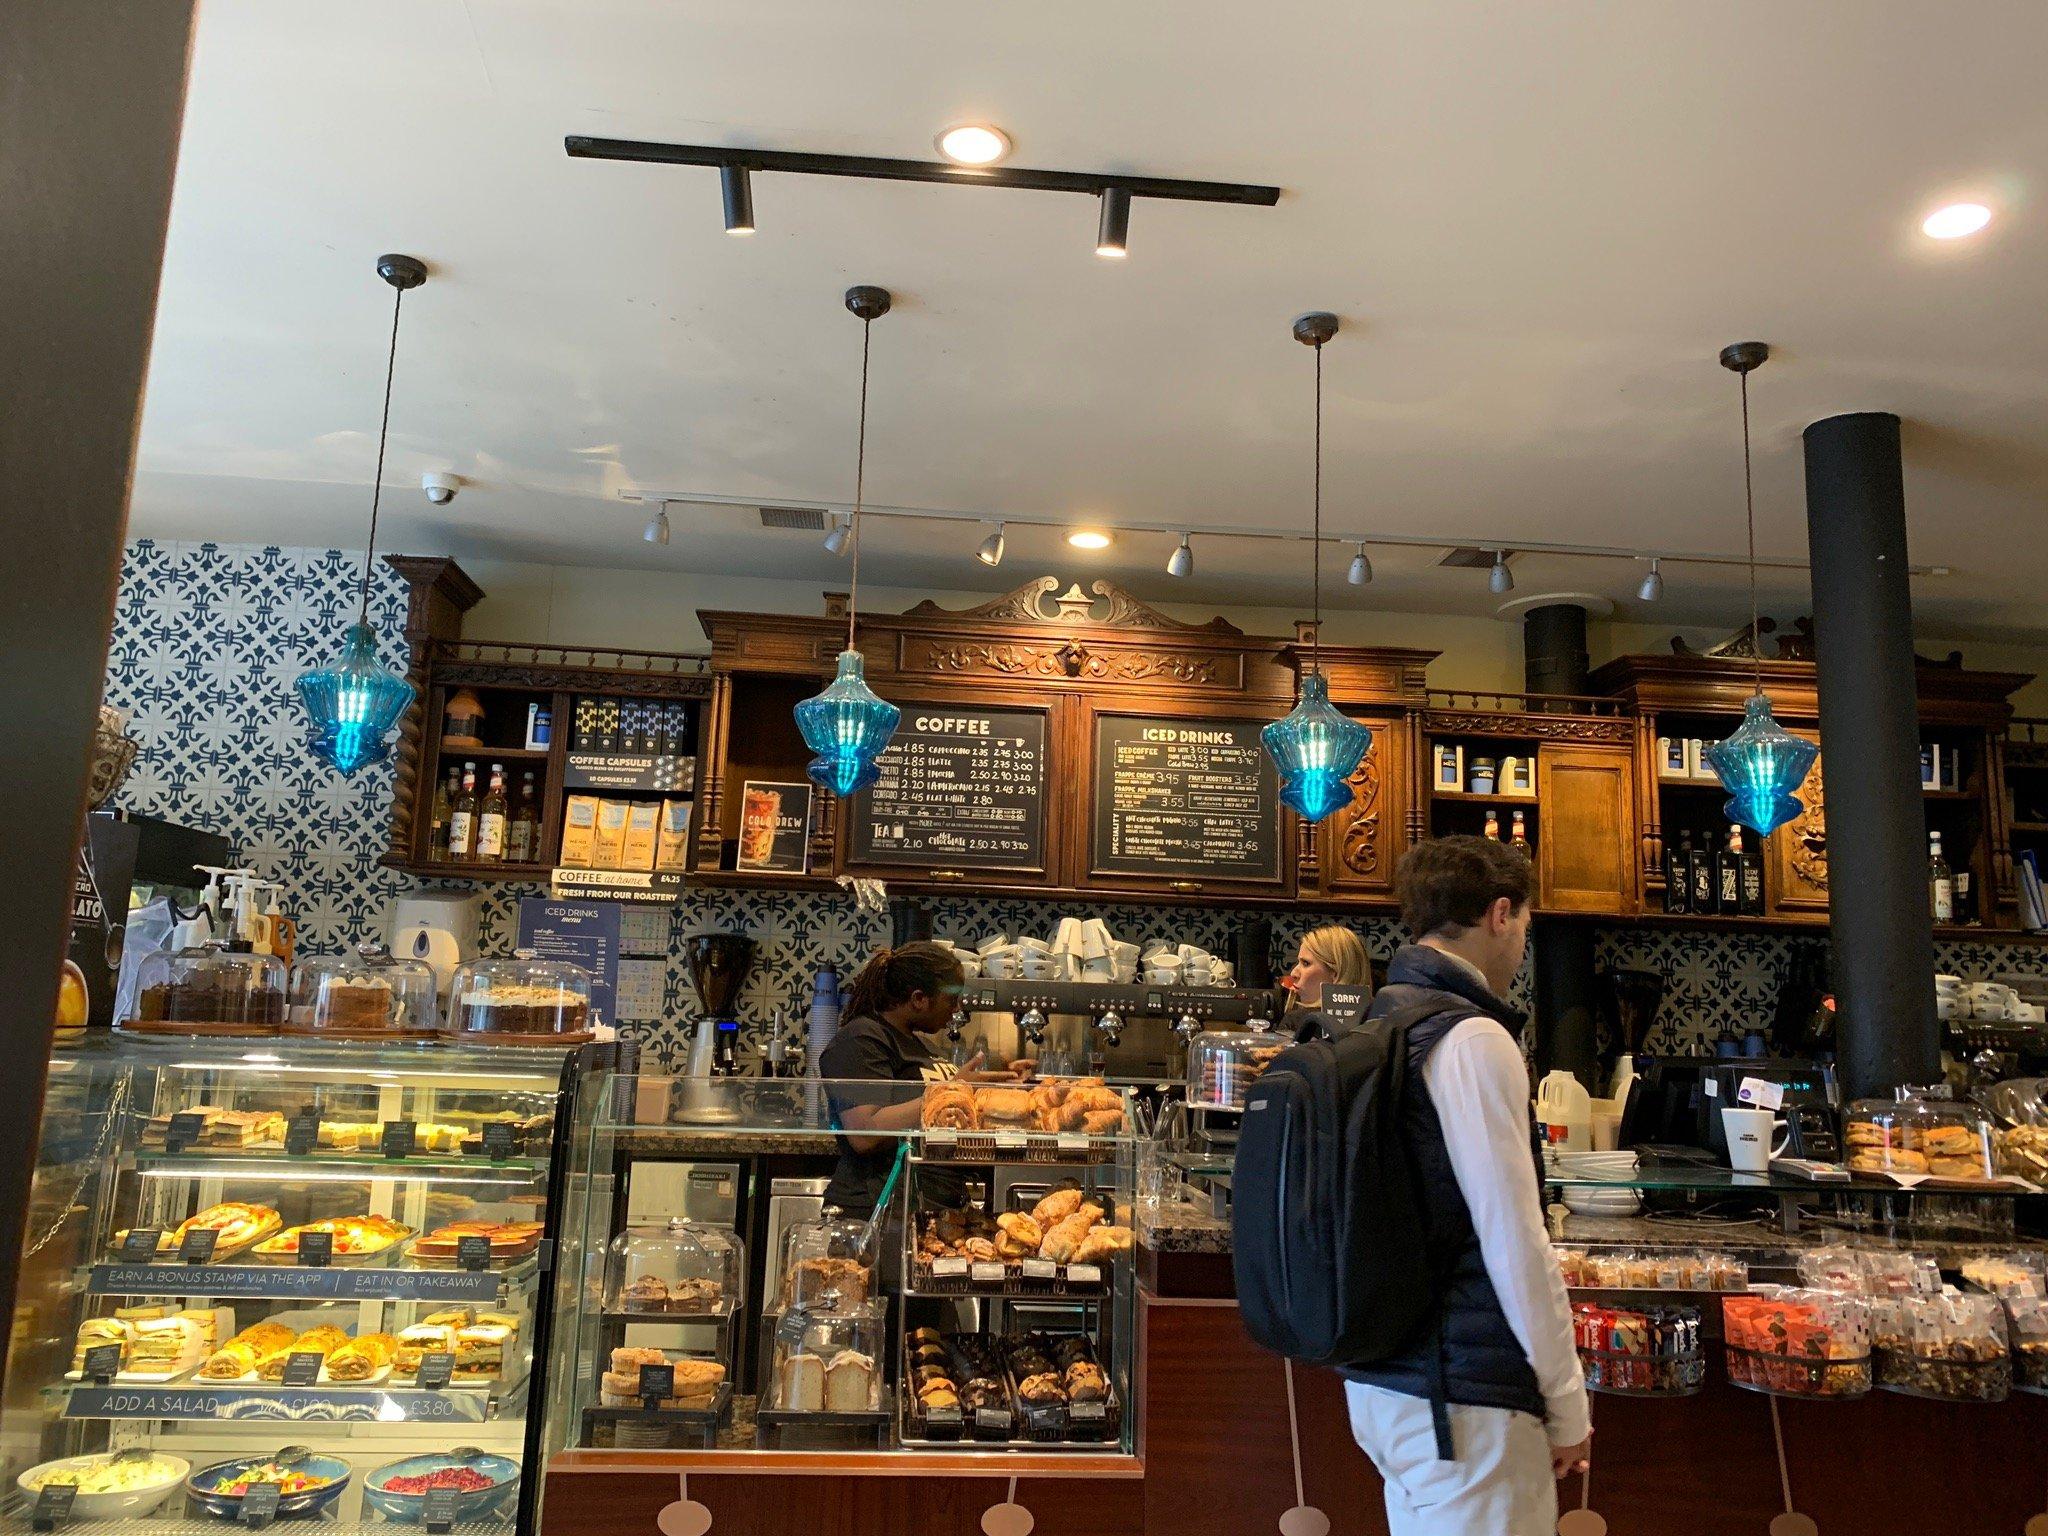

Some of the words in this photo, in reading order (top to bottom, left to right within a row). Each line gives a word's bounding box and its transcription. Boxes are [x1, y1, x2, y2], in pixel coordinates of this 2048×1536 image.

[915, 716, 990, 735] COFFEE
[1142, 728, 1177, 742] ICED
[1180, 730, 1234, 745] DRINKS
[569, 756, 605, 765] COFFEE
[607, 758, 652, 767] CAPSULES
[1156, 772, 1180, 784] 3.95
[748, 816, 772, 826] COLD
[776, 816, 802, 828] BREW
[870, 822, 890, 838] TEA
[558, 872, 602, 882] COFFEE
[618, 874, 644, 886] home
[660, 874, 680, 884] £4.25
[557, 888, 586, 897] FRESH
[586, 889, 612, 898] FROM
[612, 891, 633, 900] OUR
[634, 892, 678, 901] ROASTERY
[544, 908, 566, 916] ICED
[568, 908, 598, 918] DRINKS
[1332, 994, 1360, 1004] SORRY
[108, 1270, 144, 1282] EARN
[145, 1272, 154, 1282] A
[157, 1272, 200, 1283] BONUS
[204, 1272, 244, 1283] STAMP
[248, 1274, 268, 1284] VIA
[271, 1273, 293, 1284] THE
[296, 1274, 322, 1285] APP
[356, 1275, 378, 1286] EAT
[380, 1275, 394, 1286] IN
[396, 1276, 414, 1286] OR
[418, 1276, 482, 1288] TAKEAWAY
[101, 1396, 140, 1411] ADD
[144, 1398, 155, 1411] A
[160, 1397, 218, 1412] SALAD
[411, 1400, 454, 1416] £3.80
